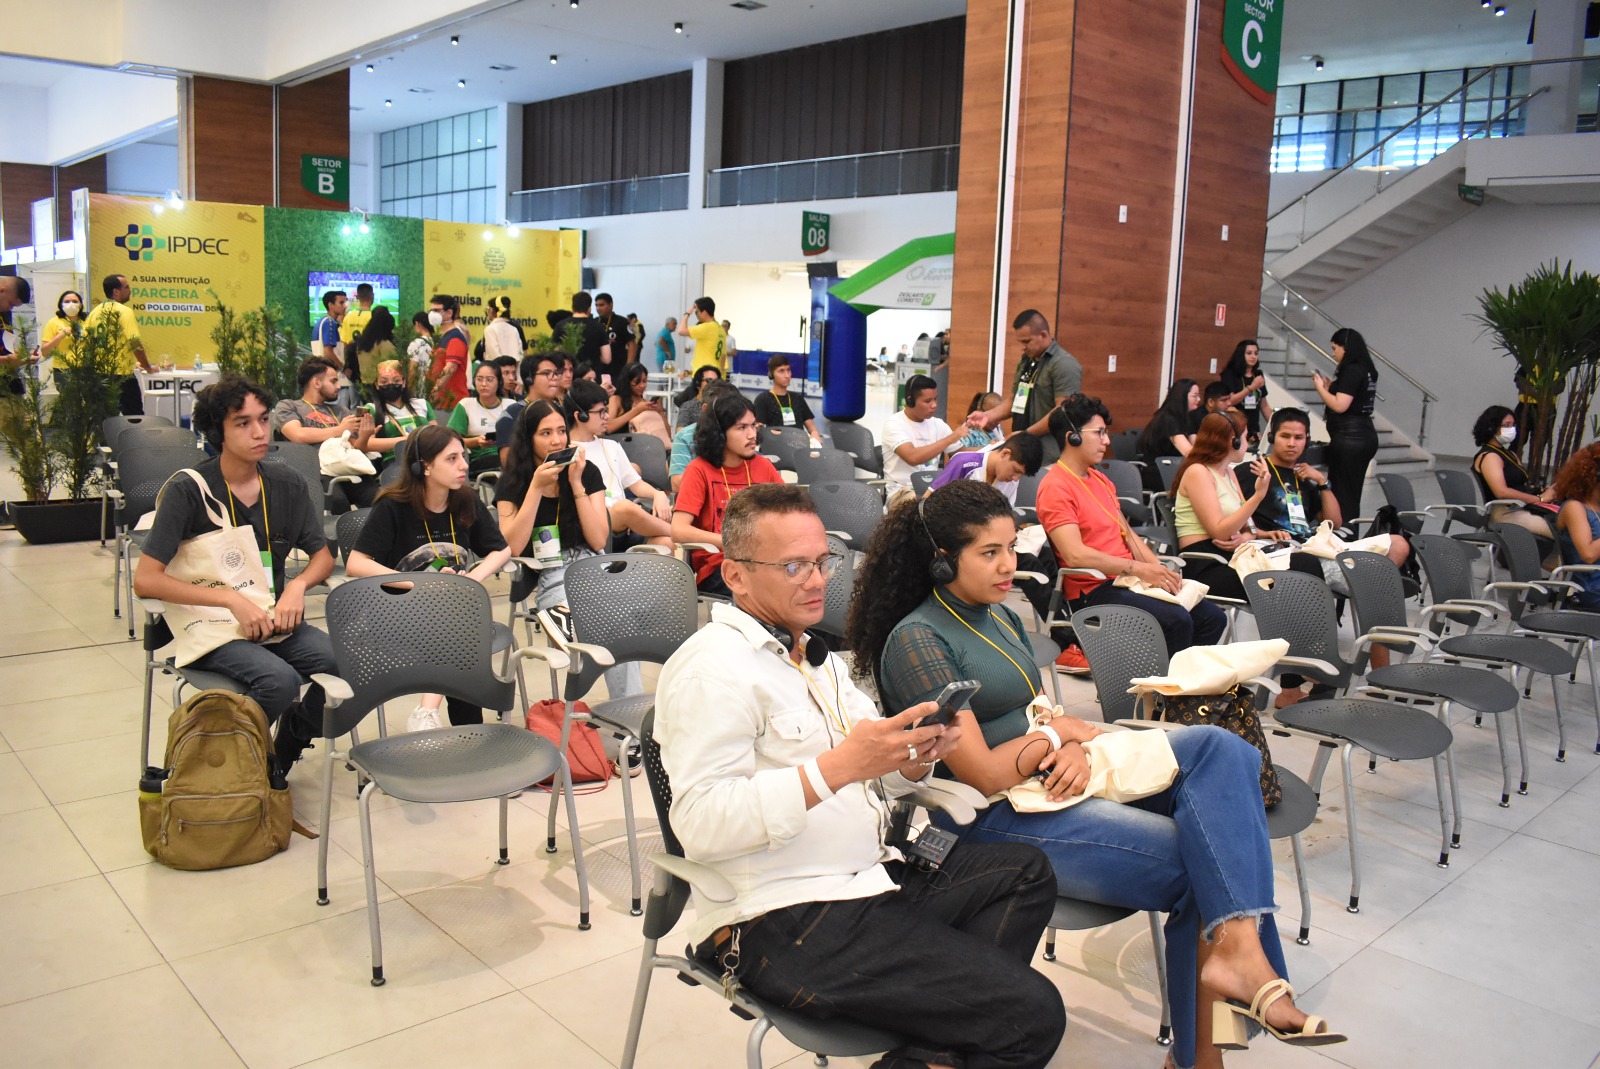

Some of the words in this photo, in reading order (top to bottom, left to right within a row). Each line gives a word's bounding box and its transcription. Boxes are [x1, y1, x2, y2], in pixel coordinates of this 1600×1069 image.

[1244, 3, 1266, 22] SECTOR
[1242, 20, 1263, 68] C
[311, 157, 342, 168] SETOR
[318, 173, 335, 194] B
[808, 213, 828, 223] SALÃO
[808, 227, 826, 247] 08
[168, 236, 229, 256] IPDEC
[158, 276, 211, 286] INSTITUIÇÃO
[132, 287, 199, 299] PARCEIRA
[147, 304, 171, 312] POLO
[136, 315, 192, 327] MANAUS
[715, 340, 723, 360] 8
